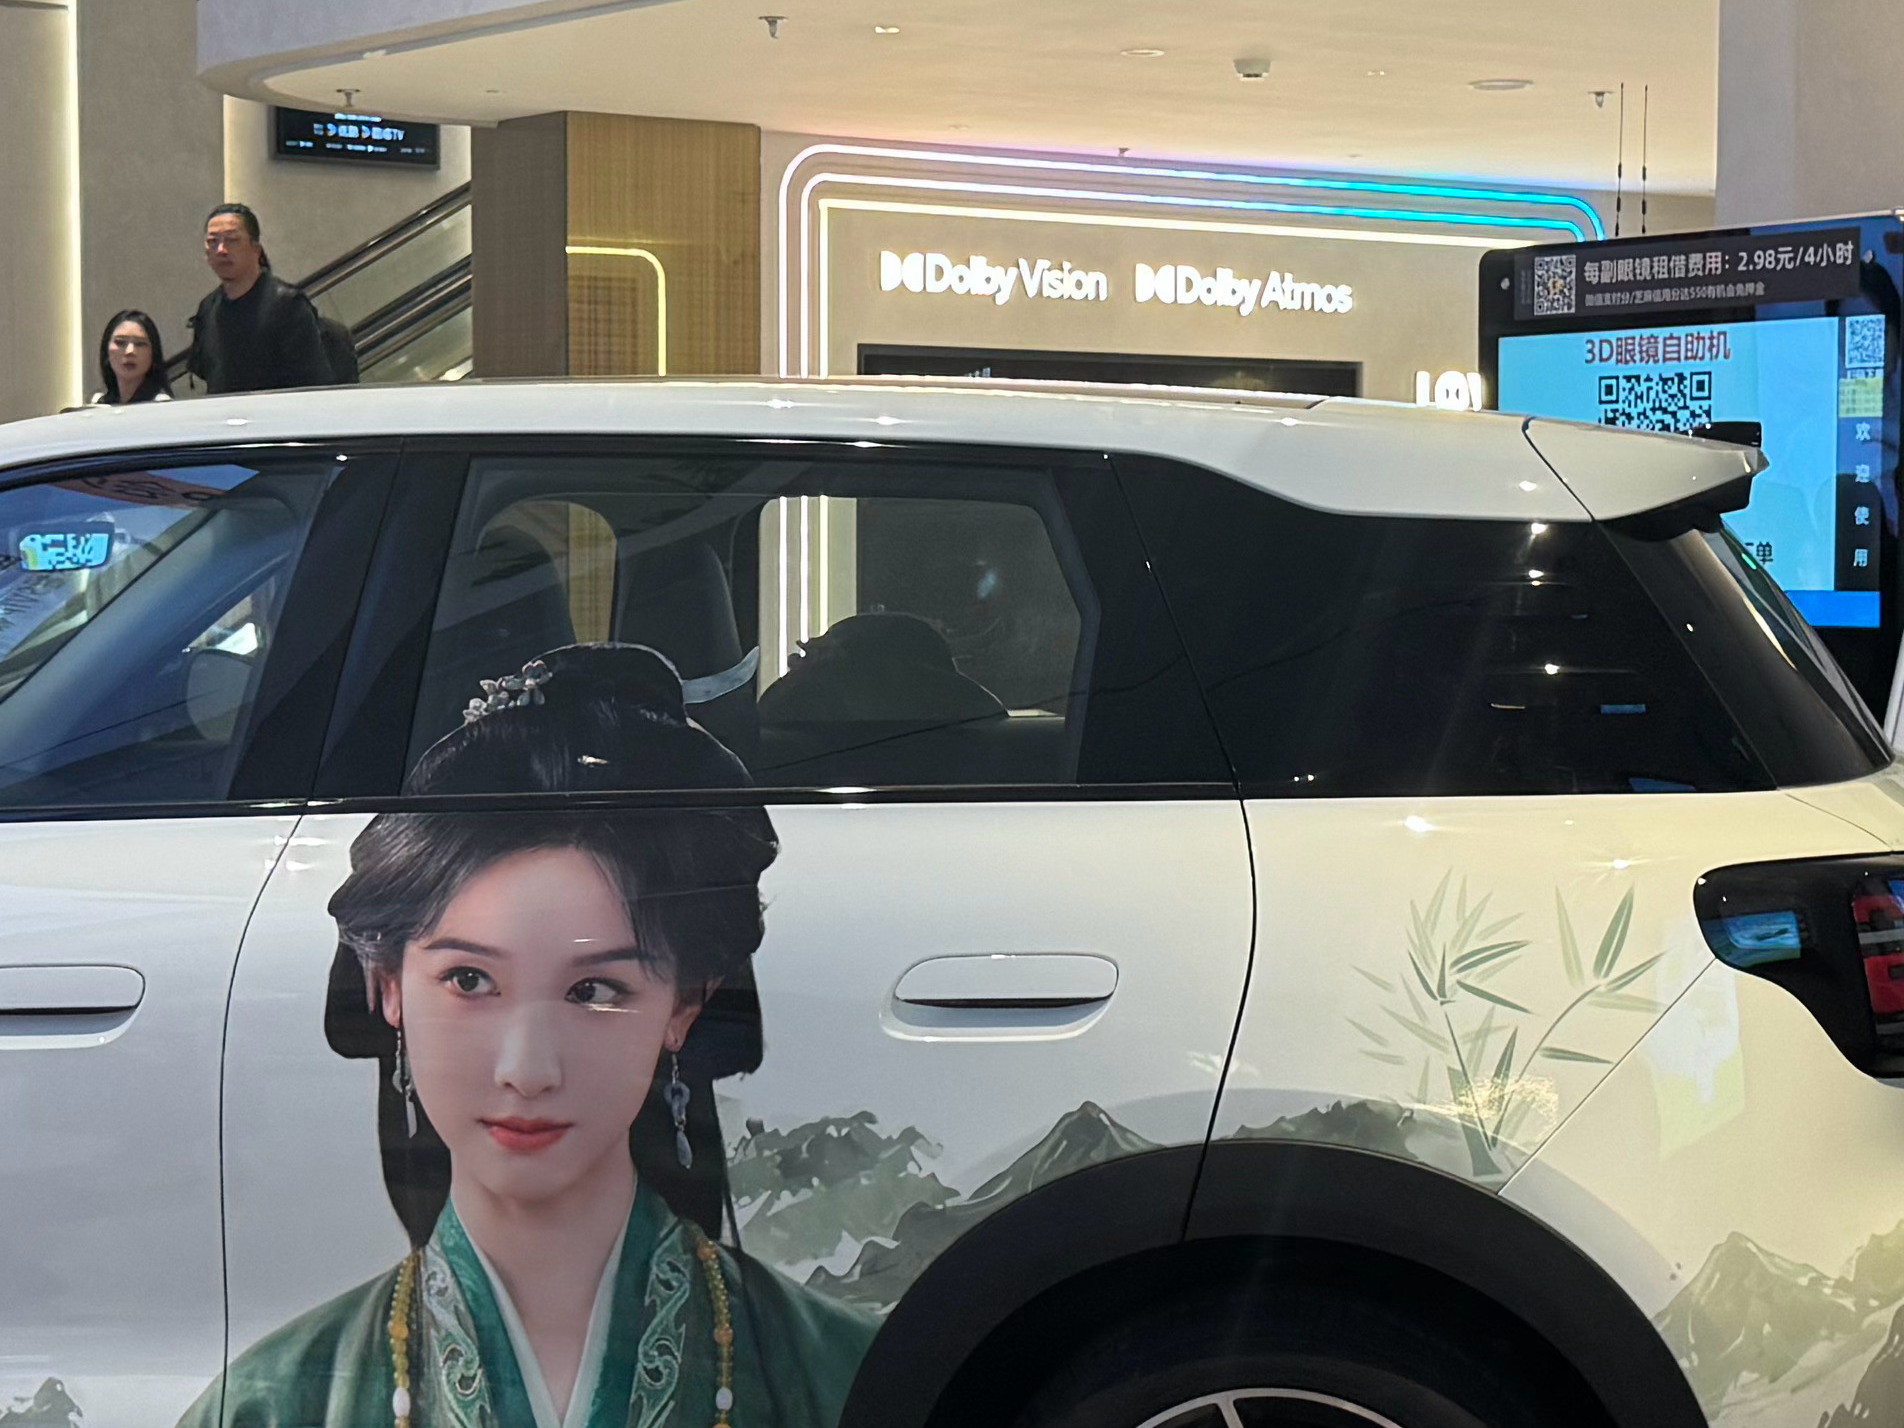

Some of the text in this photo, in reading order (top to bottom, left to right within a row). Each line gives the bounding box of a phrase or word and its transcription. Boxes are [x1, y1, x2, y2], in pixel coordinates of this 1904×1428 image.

[924, 252, 1108, 305] Dolby Vision
[1176, 264, 1353, 316] Dolby Atmos
[1584, 330, 1732, 366] 3D眼镜自助机
